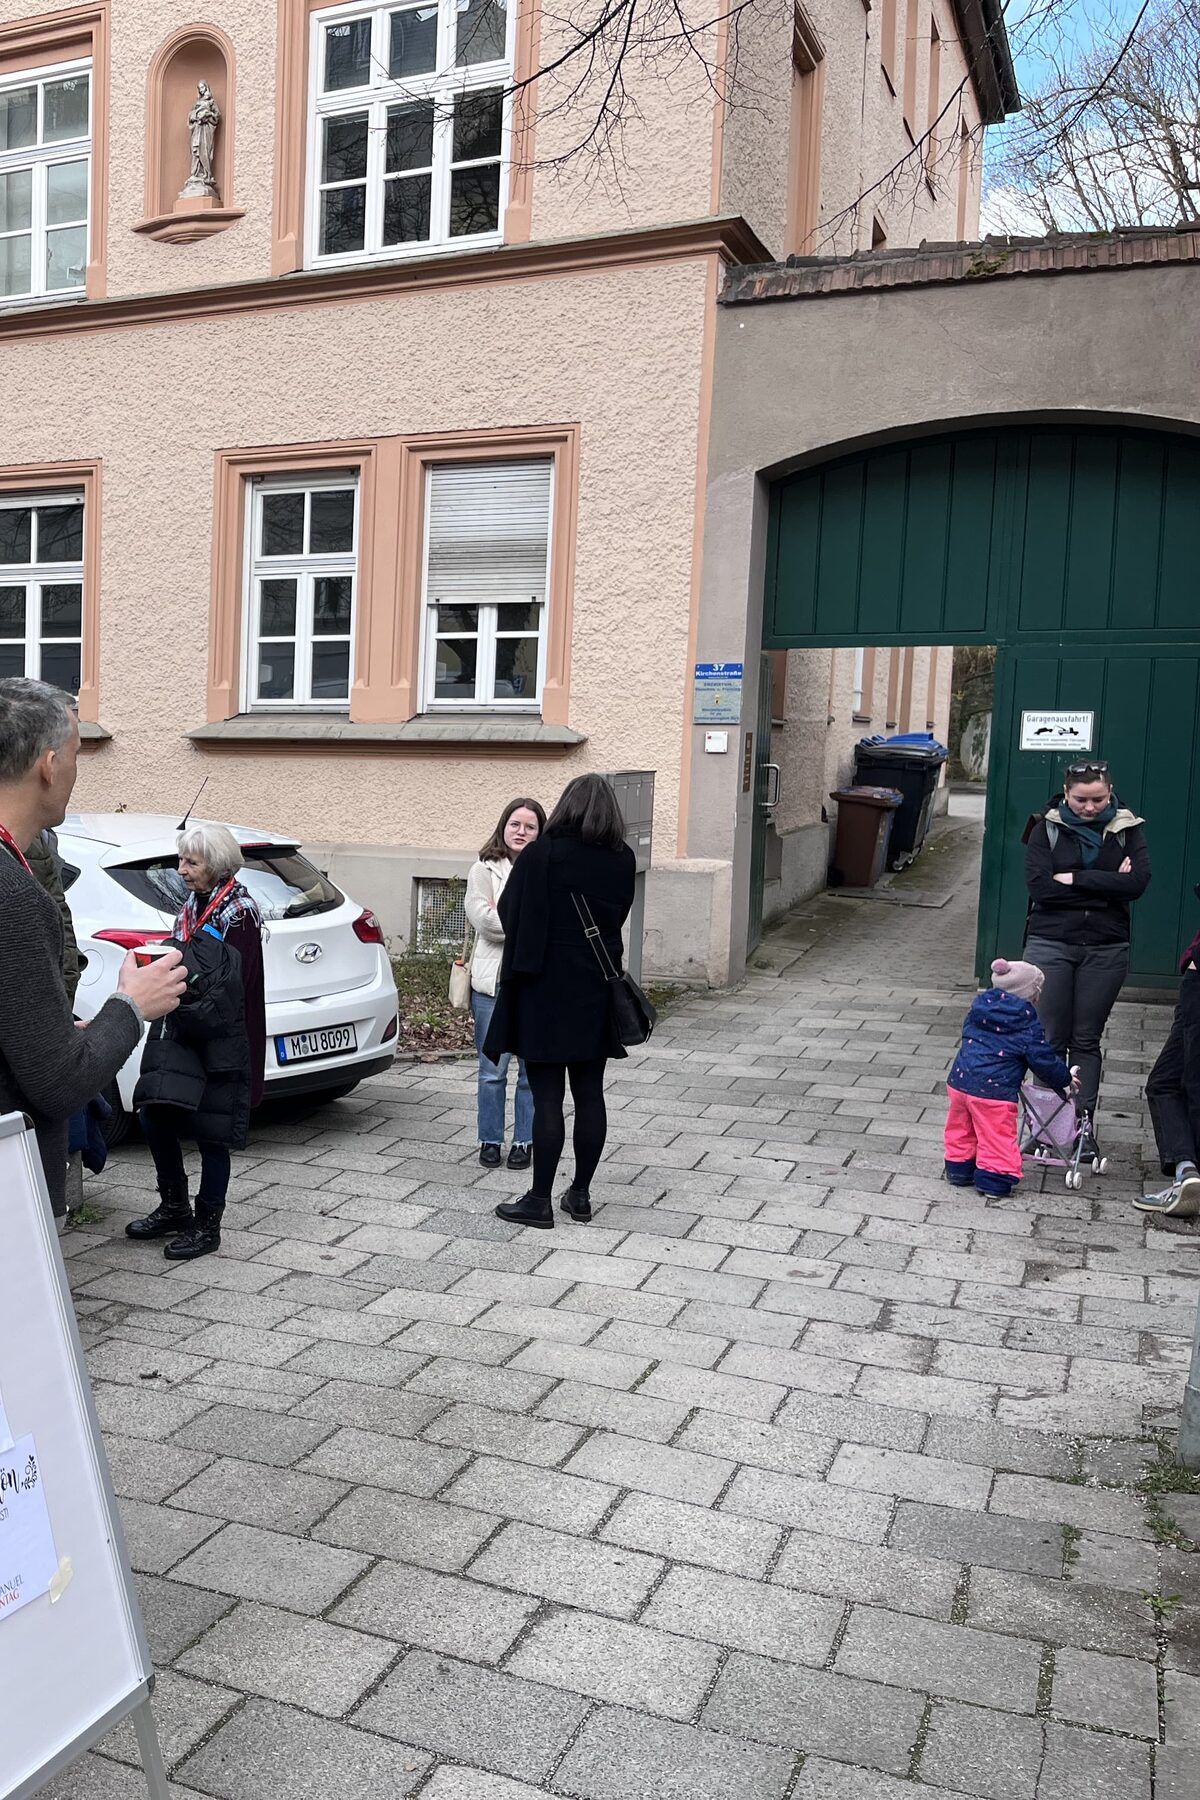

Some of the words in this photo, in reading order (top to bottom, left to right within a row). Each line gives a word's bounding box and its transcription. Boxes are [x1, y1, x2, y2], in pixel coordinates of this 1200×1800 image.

[1026, 715, 1089, 724] Garagenausfahrt!
[291, 1037, 301, 1056] M
[309, 1034, 318, 1052] U
[320, 1029, 350, 1051] 8099
